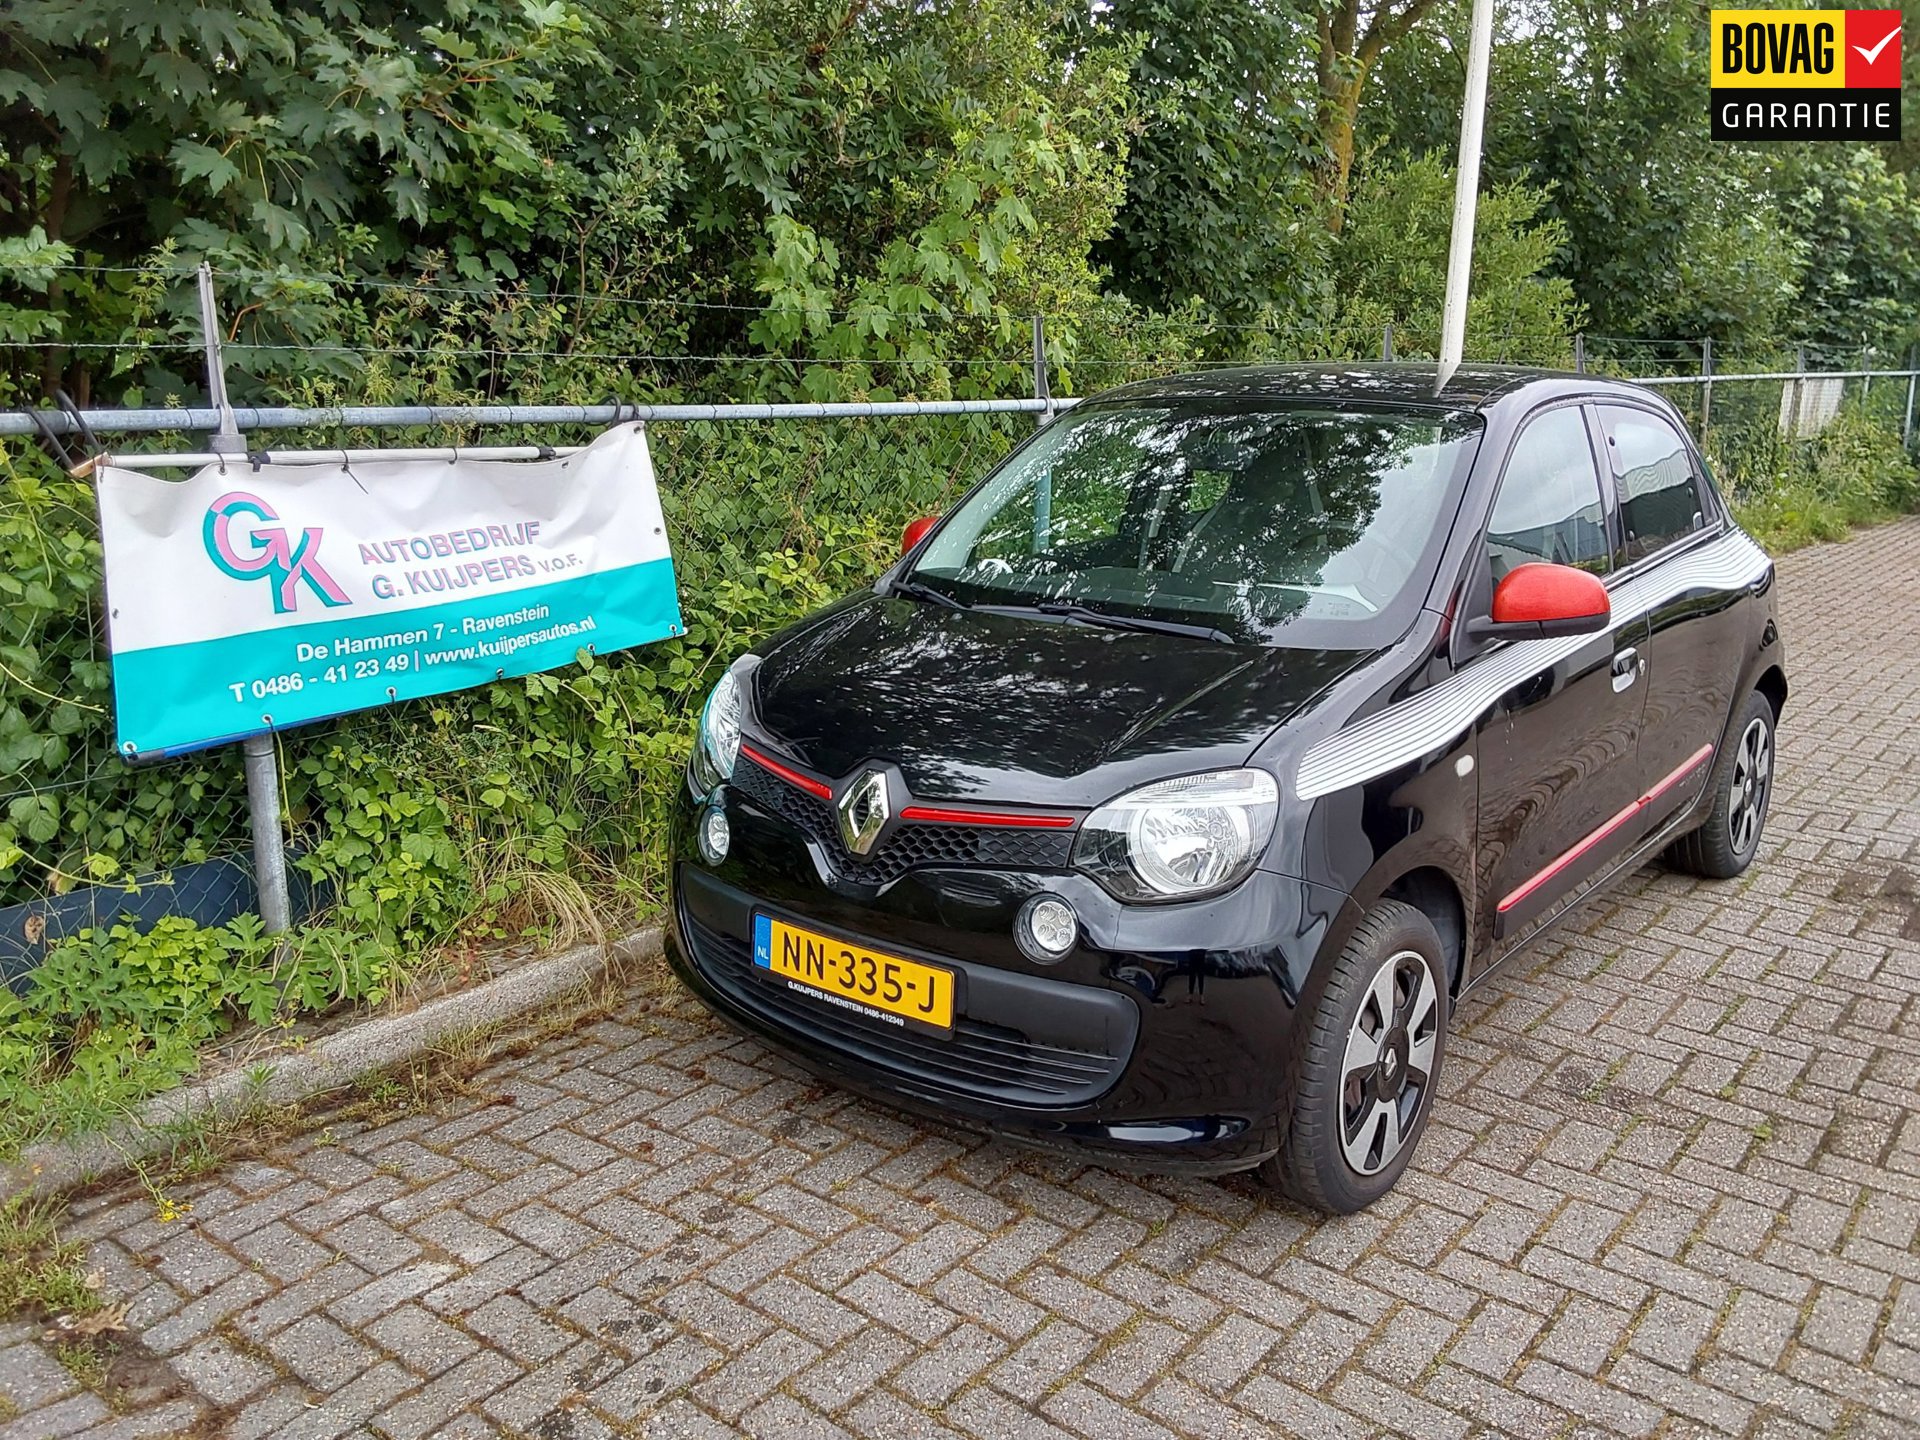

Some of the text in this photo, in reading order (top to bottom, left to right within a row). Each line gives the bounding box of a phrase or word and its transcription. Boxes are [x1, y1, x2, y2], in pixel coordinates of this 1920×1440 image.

[203, 491, 353, 614] GK
[358, 521, 540, 565] AUTOBEDRIJF
[371, 553, 584, 599] G. KUIJPERS V.O.F.
[228, 682, 246, 702] T
[251, 672, 304, 699] 0486
[323, 664, 347, 684] 41
[354, 658, 380, 679] 23
[384, 654, 410, 673] 49
[424, 616, 597, 665] www.kuijpersautos.nl
[296, 643, 329, 663] De
[334, 629, 428, 656] Hammen
[433, 623, 444, 641] 7
[462, 604, 549, 635] Ravenstein
[757, 944, 769, 960] NL
[783, 931, 935, 1013] NN-335-J
[823, 993, 864, 1014] RAVENSTEIN
[863, 1007, 905, 1027] 0486-412349
